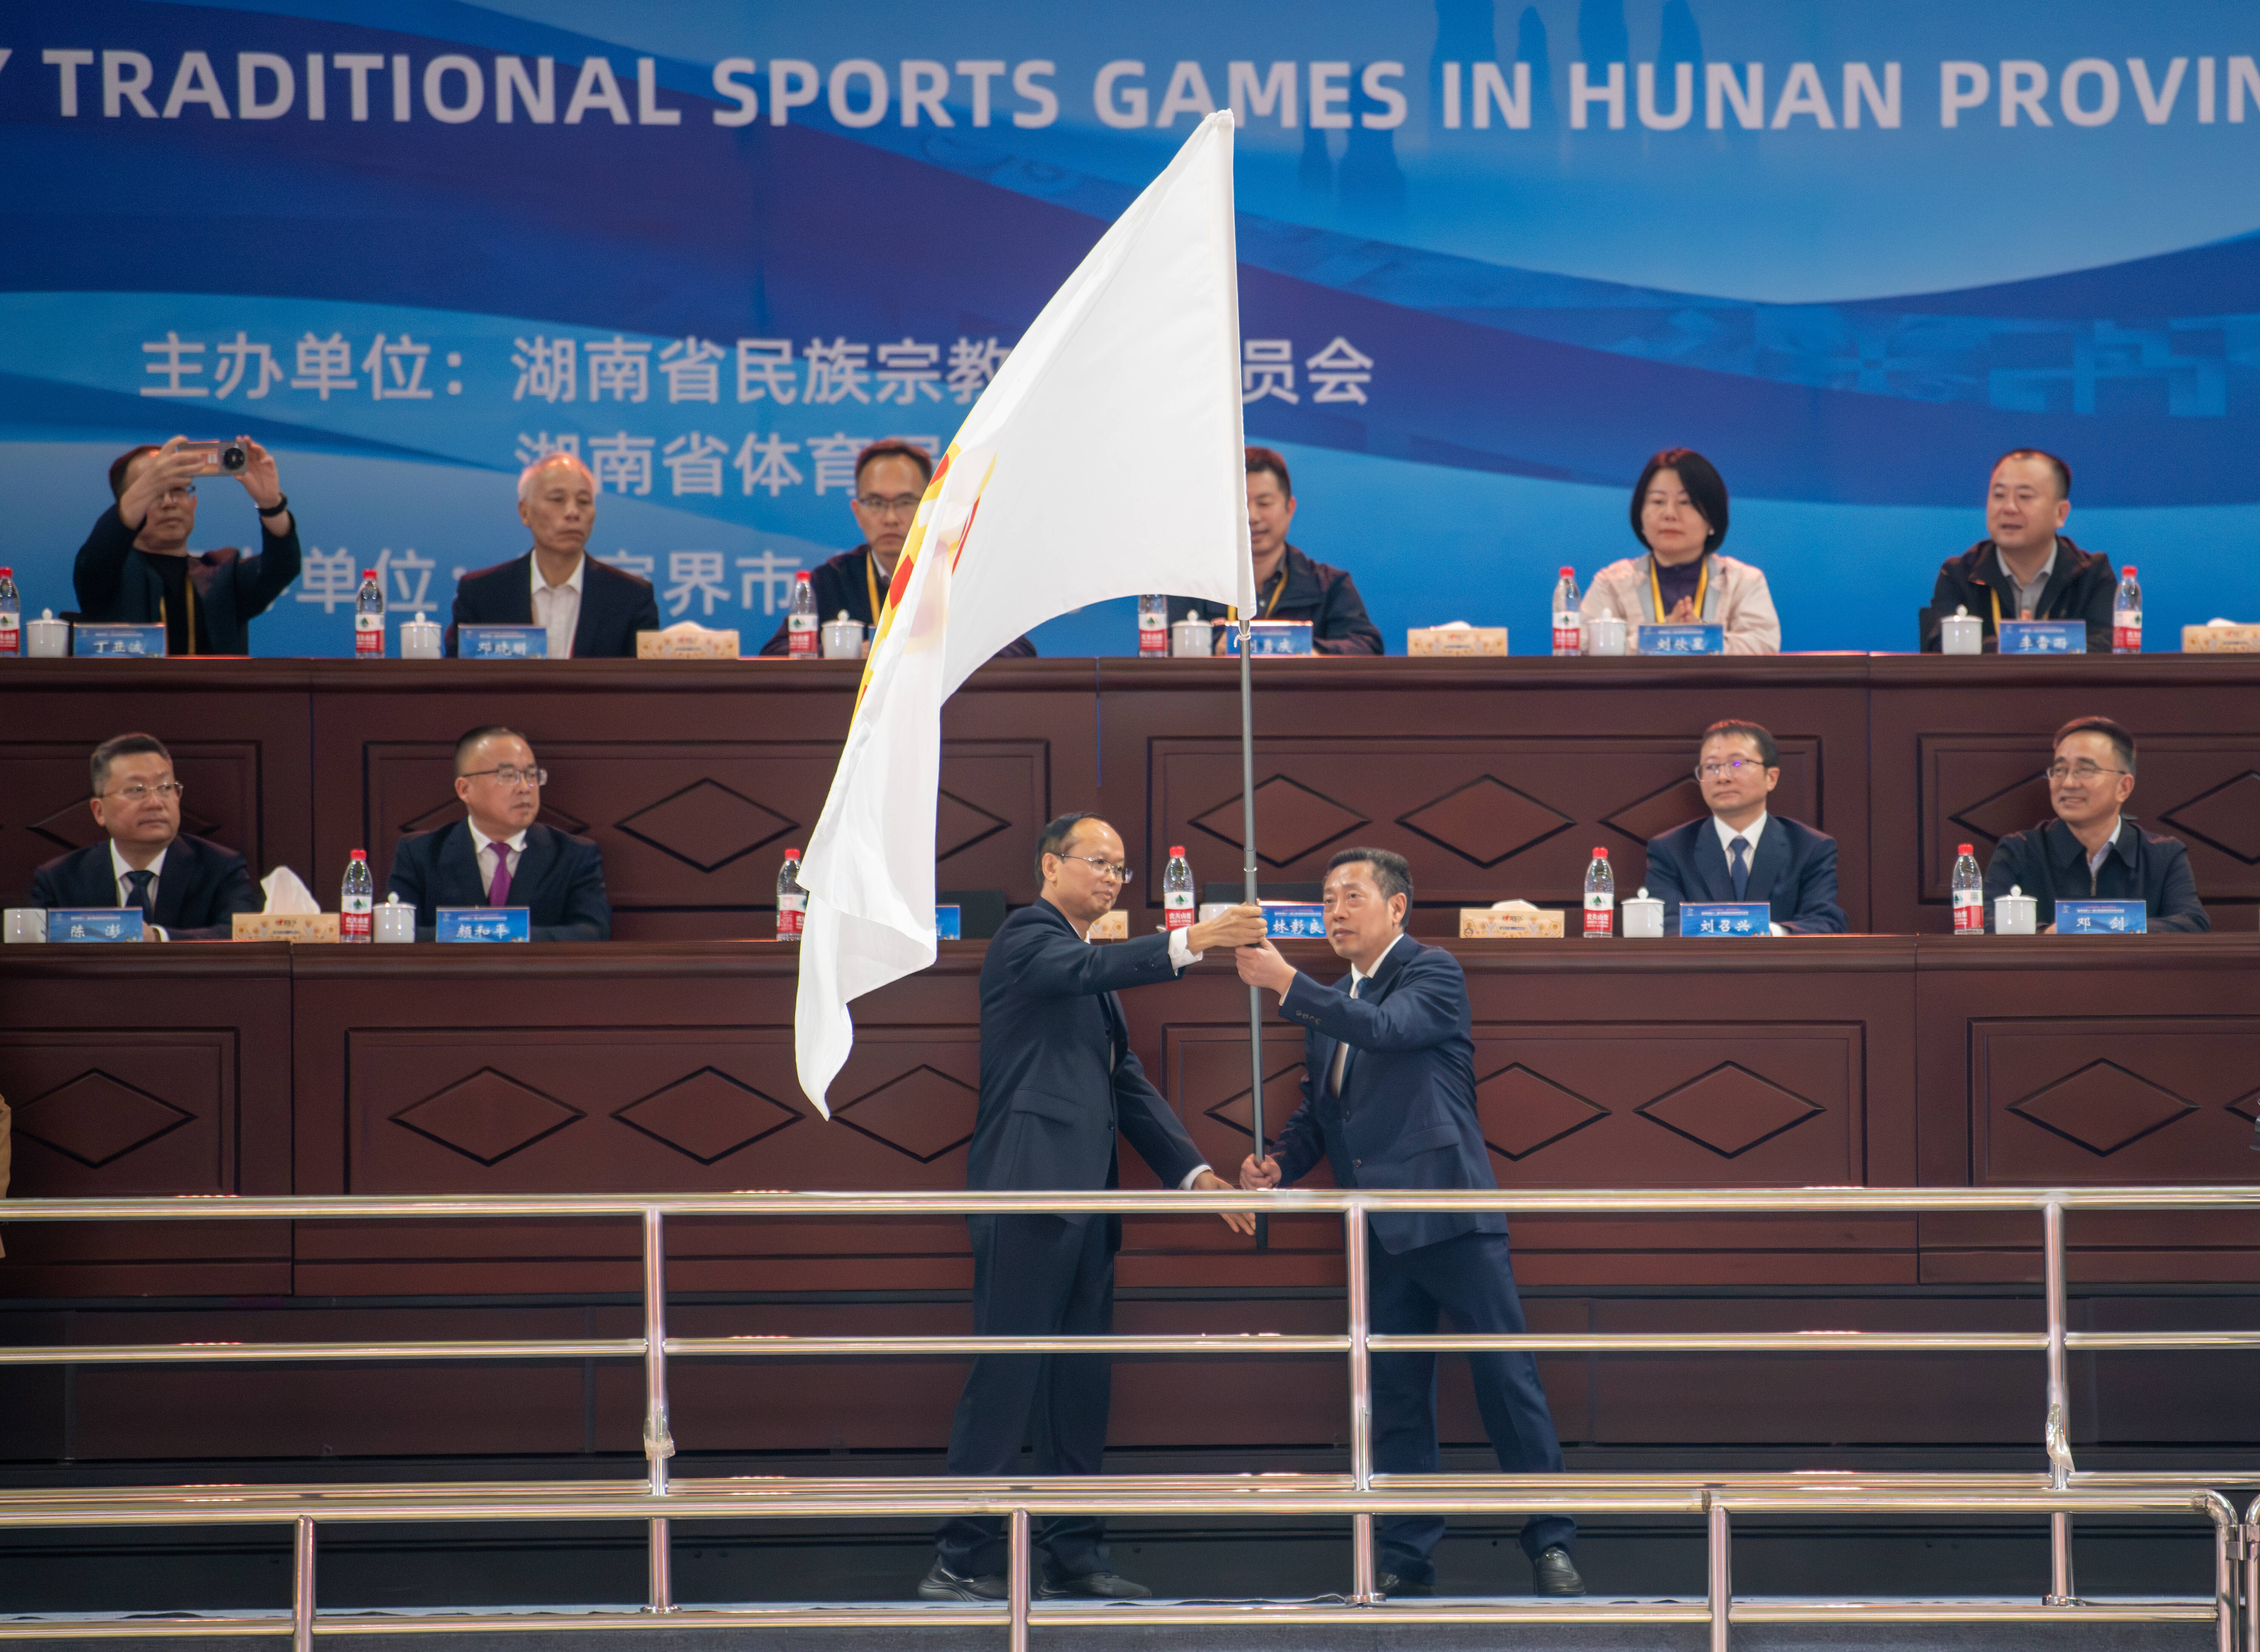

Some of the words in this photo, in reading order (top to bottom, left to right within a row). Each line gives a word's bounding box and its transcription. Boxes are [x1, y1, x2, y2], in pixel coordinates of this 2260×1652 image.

[42, 49, 682, 125] TRADITIONAL
[712, 58, 1060, 129] SPORTS
[1093, 60, 1408, 129] GAMES
[1442, 61, 1531, 129] IN
[1569, 61, 1902, 130] HUNAN
[139, 332, 462, 401] 主办单位：
[1700, 919, 1750, 933] 刘召兴
